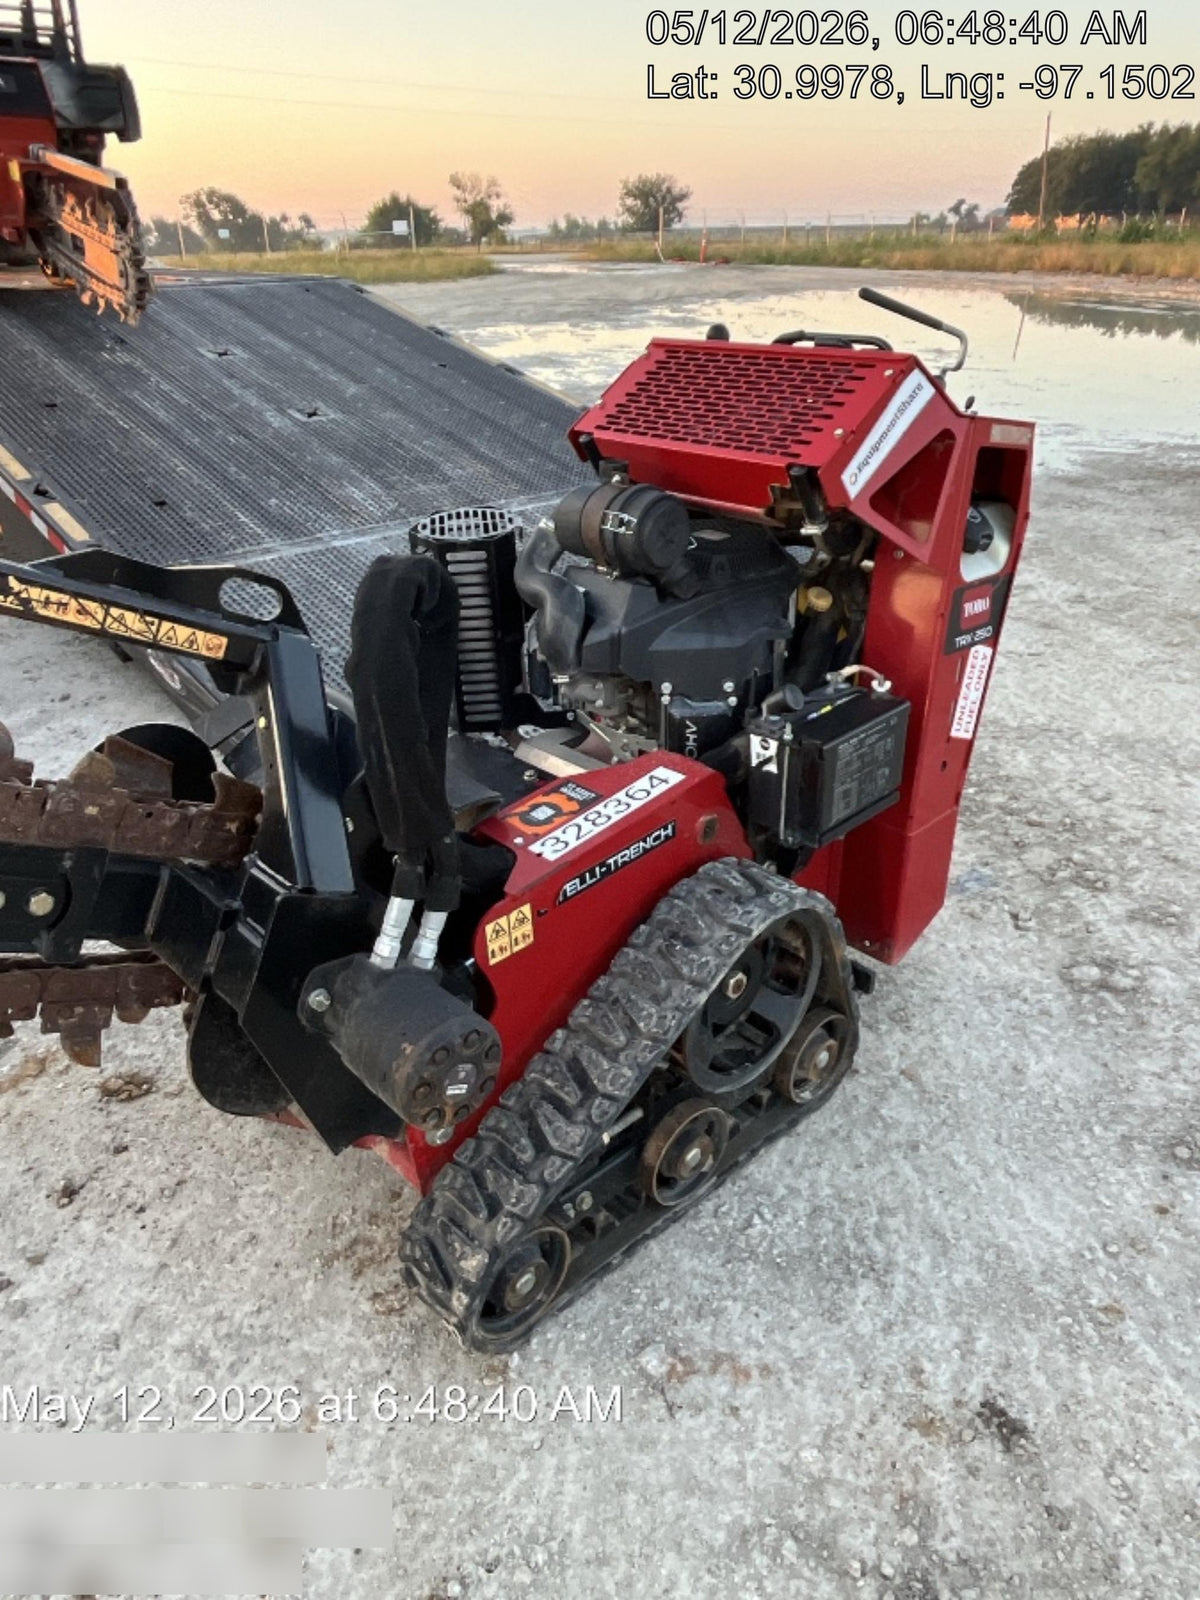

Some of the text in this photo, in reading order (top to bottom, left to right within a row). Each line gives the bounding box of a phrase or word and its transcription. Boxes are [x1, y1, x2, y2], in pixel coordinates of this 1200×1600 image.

[857, 382, 925, 473] EquipmentShare
[954, 650, 980, 732] UNLEADED
[963, 651, 988, 734] FUEL ONLY
[685, 720, 698, 758] OHV
[540, 774, 670, 853] 328364
